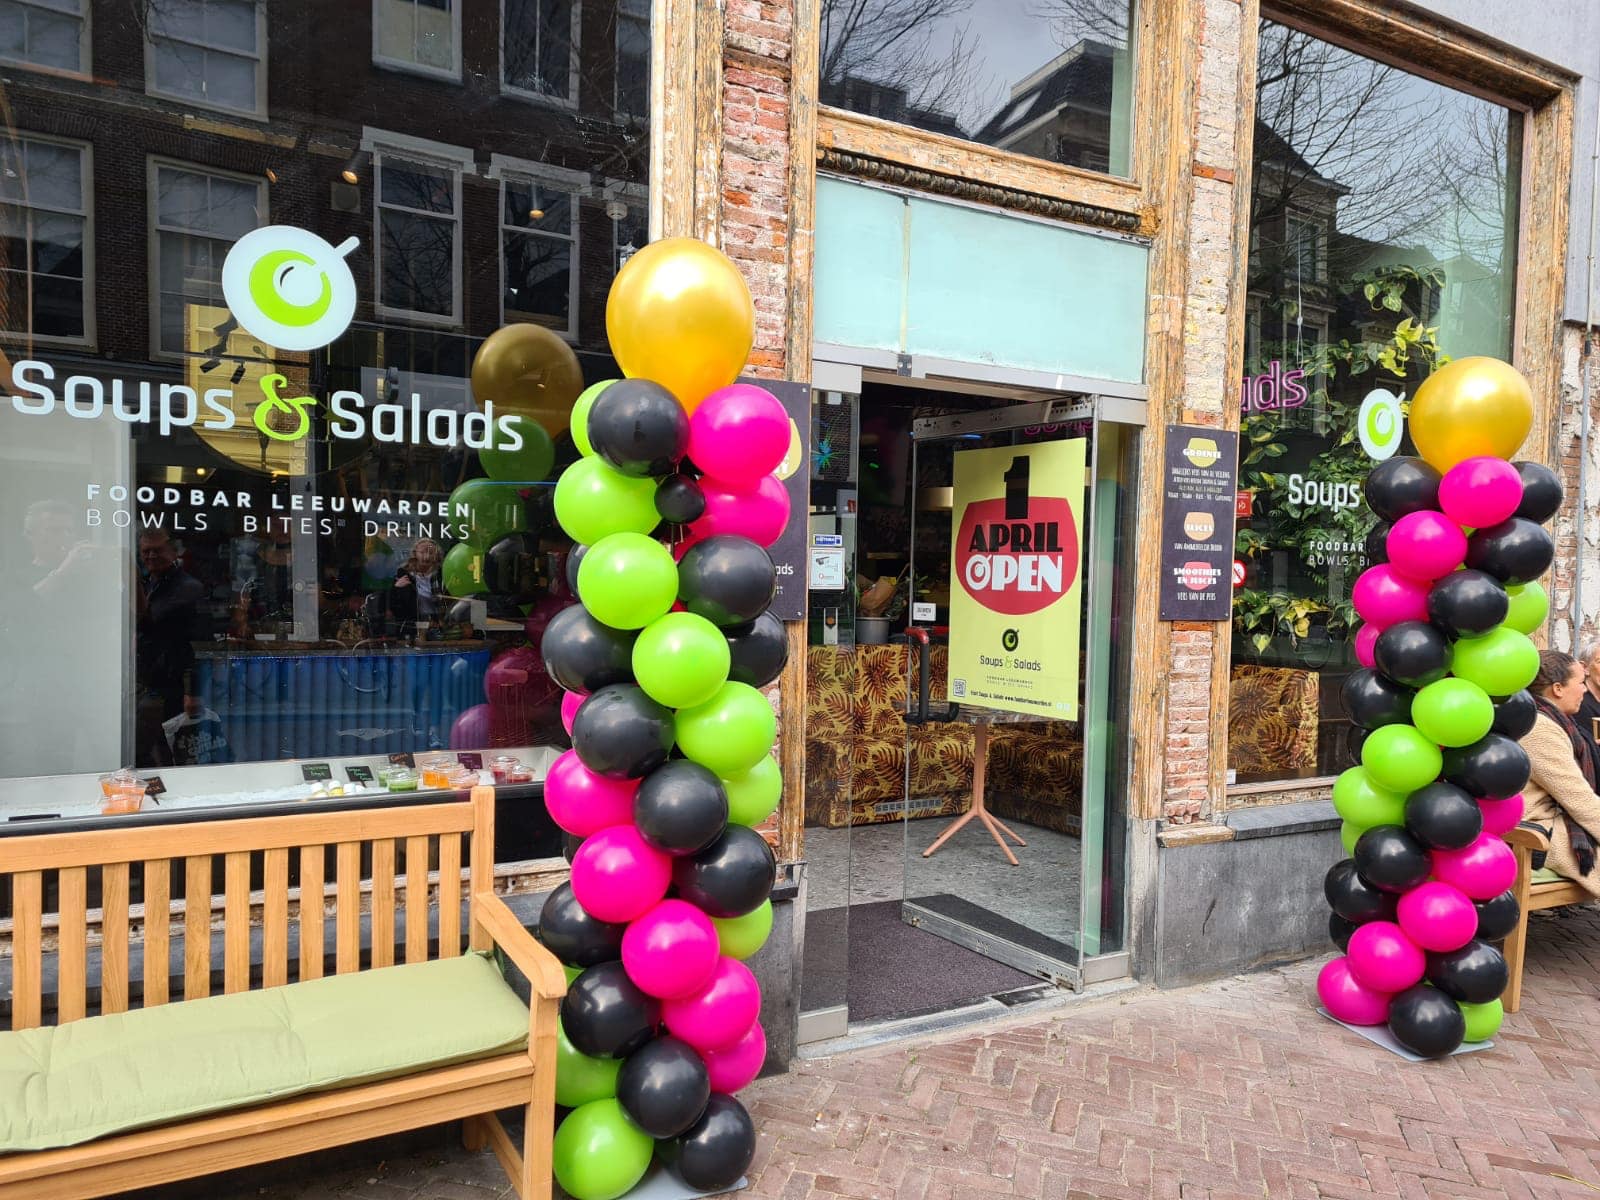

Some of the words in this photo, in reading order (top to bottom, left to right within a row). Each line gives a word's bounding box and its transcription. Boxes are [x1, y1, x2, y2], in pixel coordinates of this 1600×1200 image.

[12, 359, 236, 435] Soups
[253, 372, 317, 441] &
[330, 390, 524, 451] Salads
[87, 484, 252, 508] FOODBAR
[271, 494, 470, 518] LEEUWARDEN
[1004, 455, 1030, 520] 1
[1288, 473, 1361, 512] Soups
[87, 509, 208, 532] BOWLS
[243, 515, 332, 535] BITES
[364, 520, 470, 540] DRINKS
[968, 521, 1064, 553] APRIL
[1309, 540, 1364, 553] FOODBAR
[1309, 554, 1350, 566] BOWLS
[965, 554, 1063, 593] OPEN
[1173, 567, 1221, 576] SMOOTHIES
[1177, 592, 1188, 600] VERS
[1188, 592, 1199, 600] VAN
[980, 655, 1003, 667] Soups
[1004, 656, 1013, 669] &
[1013, 659, 1041, 671] Salads
